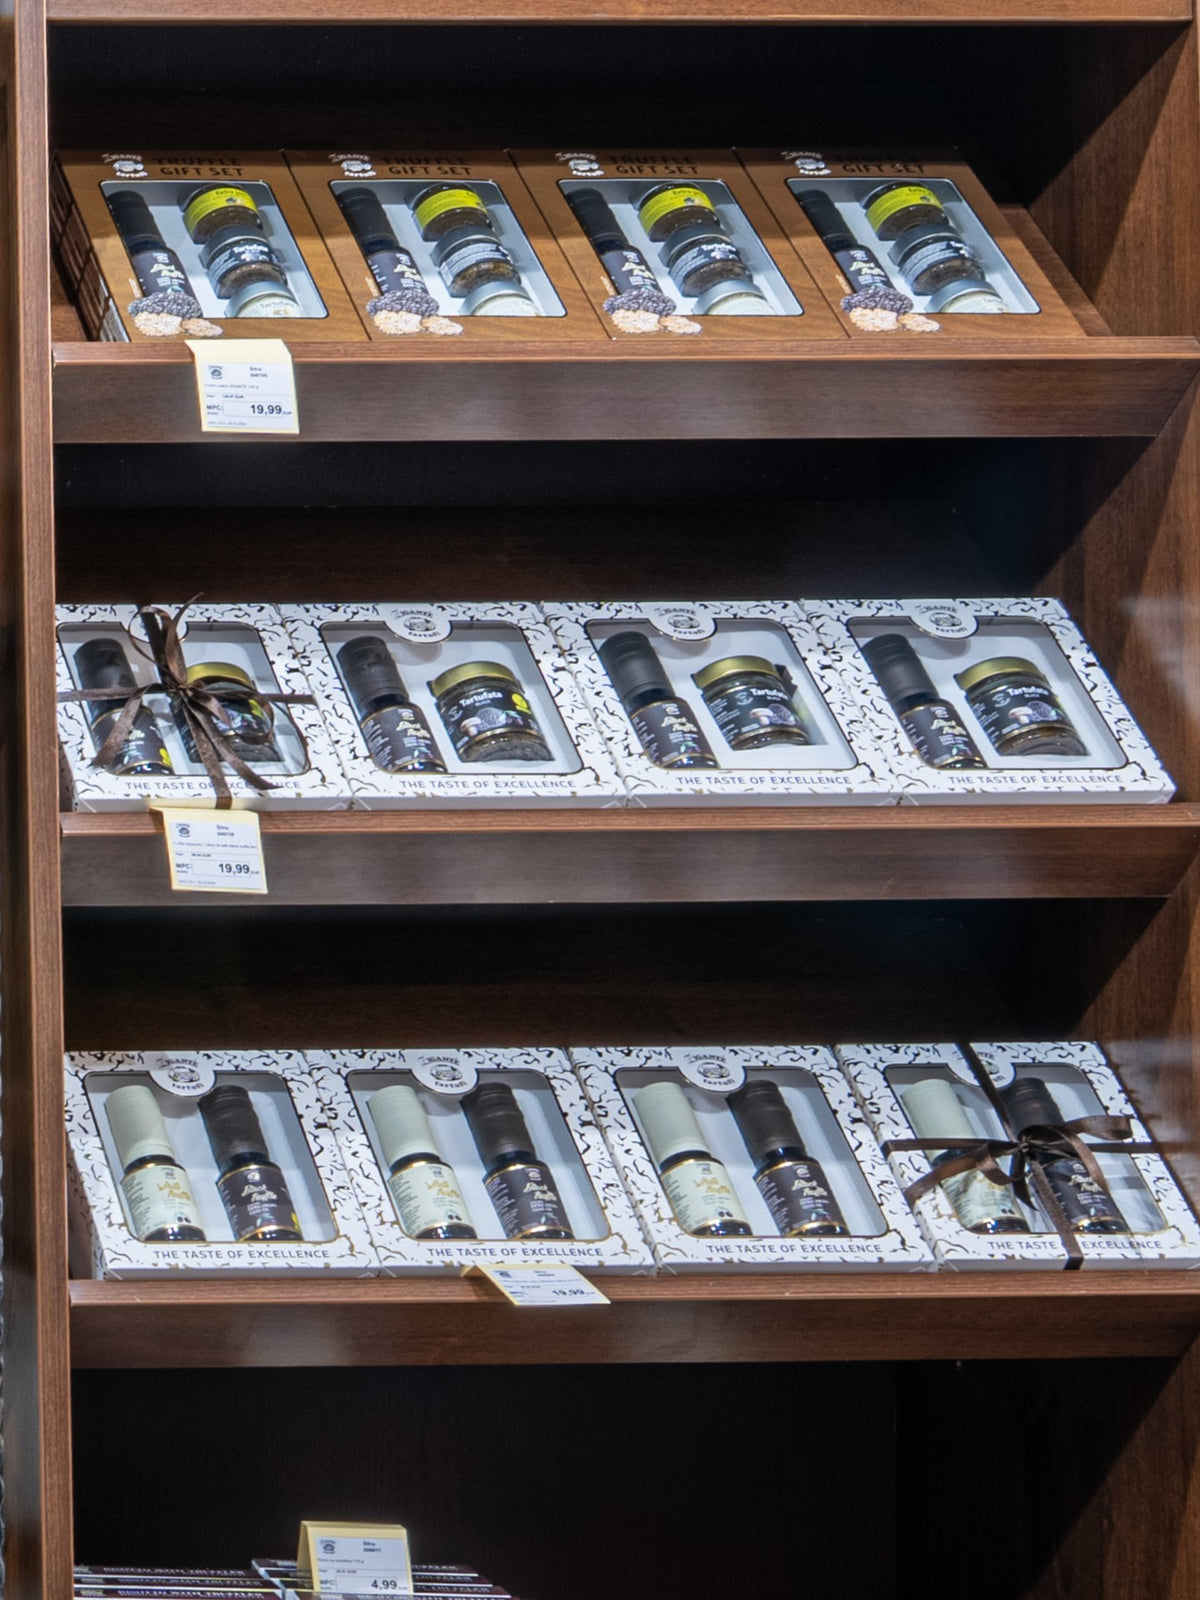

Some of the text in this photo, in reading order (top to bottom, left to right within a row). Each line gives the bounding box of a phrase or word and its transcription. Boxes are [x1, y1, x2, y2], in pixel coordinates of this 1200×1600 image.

[160, 167, 245, 176] GIFT SET
[389, 166, 472, 176] GIFT SET
[616, 165, 699, 175] GIFT SET
[842, 164, 926, 174] GIFT SET
[250, 404, 282, 415] 19,99
[749, 688, 789, 700] Tartufata
[1006, 686, 1049, 696] Tartufata
[459, 690, 503, 707] Tartufata
[400, 780, 576, 789] THE TASTE OF EXCELLENCE
[676, 776, 852, 785] THE TASTE OF EXCELLENCE
[949, 775, 1123, 785] THE TASTE OF EXCELLENCE
[125, 782, 150, 790] THE
[155, 782, 194, 790] TASTE
[218, 863, 250, 875] 19,99
[706, 1244, 882, 1254] THE TASTE OF EXCELLENCE
[987, 1240, 1162, 1250] THE TASTE EXCELLENCE
[153, 1249, 330, 1259] THE TASTE OF EXCELLENCE
[427, 1248, 603, 1257] THE TASTE OF EXCELLENCE
[552, 1289, 585, 1297] 19,99
[371, 1579, 397, 1591] 4,99
